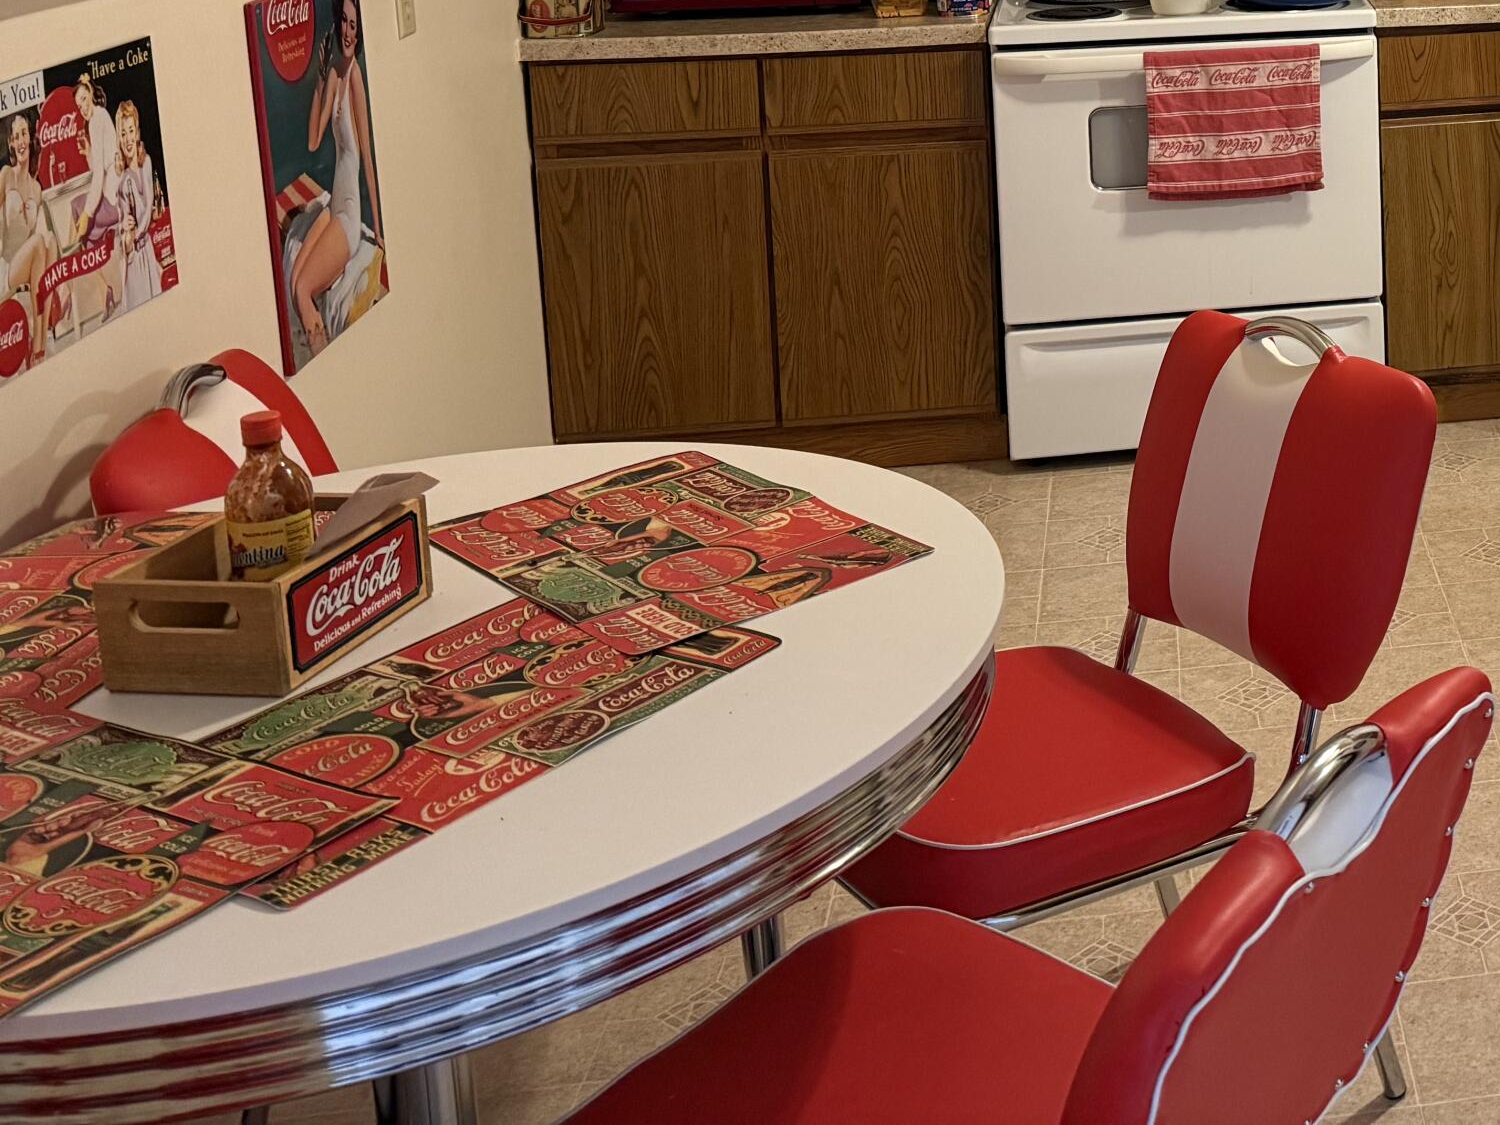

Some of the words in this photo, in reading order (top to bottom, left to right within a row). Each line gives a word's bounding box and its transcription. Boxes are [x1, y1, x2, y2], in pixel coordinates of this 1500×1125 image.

[118, 61, 124, 71] a
[1151, 70, 1200, 89] Coca-Cola
[1210, 66, 1260, 85] Coca-Cola
[1266, 62, 1316, 83] Coca-Cola
[10, 77, 41, 107] You!
[40, 112, 78, 148] Coca-Cola
[44, 262, 69, 291] HAVE
[72, 261, 78, 275] A
[81, 245, 108, 271] COKE
[306, 533, 404, 637] Coca-Cola
[329, 555, 360, 583] Drink
[314, 621, 350, 651] Delicious
[351, 614, 362, 627] and
[362, 583, 402, 621] Refreshing
[598, 665, 694, 713] Coca-Cola
[446, 687, 556, 746] Coca-Cola
[420, 757, 538, 823] Coca-Cola
[272, 861, 338, 897] THIRST
[348, 829, 401, 859] ASKS
[282, 863, 356, 905] NOTHING
[365, 833, 414, 861] MORE
